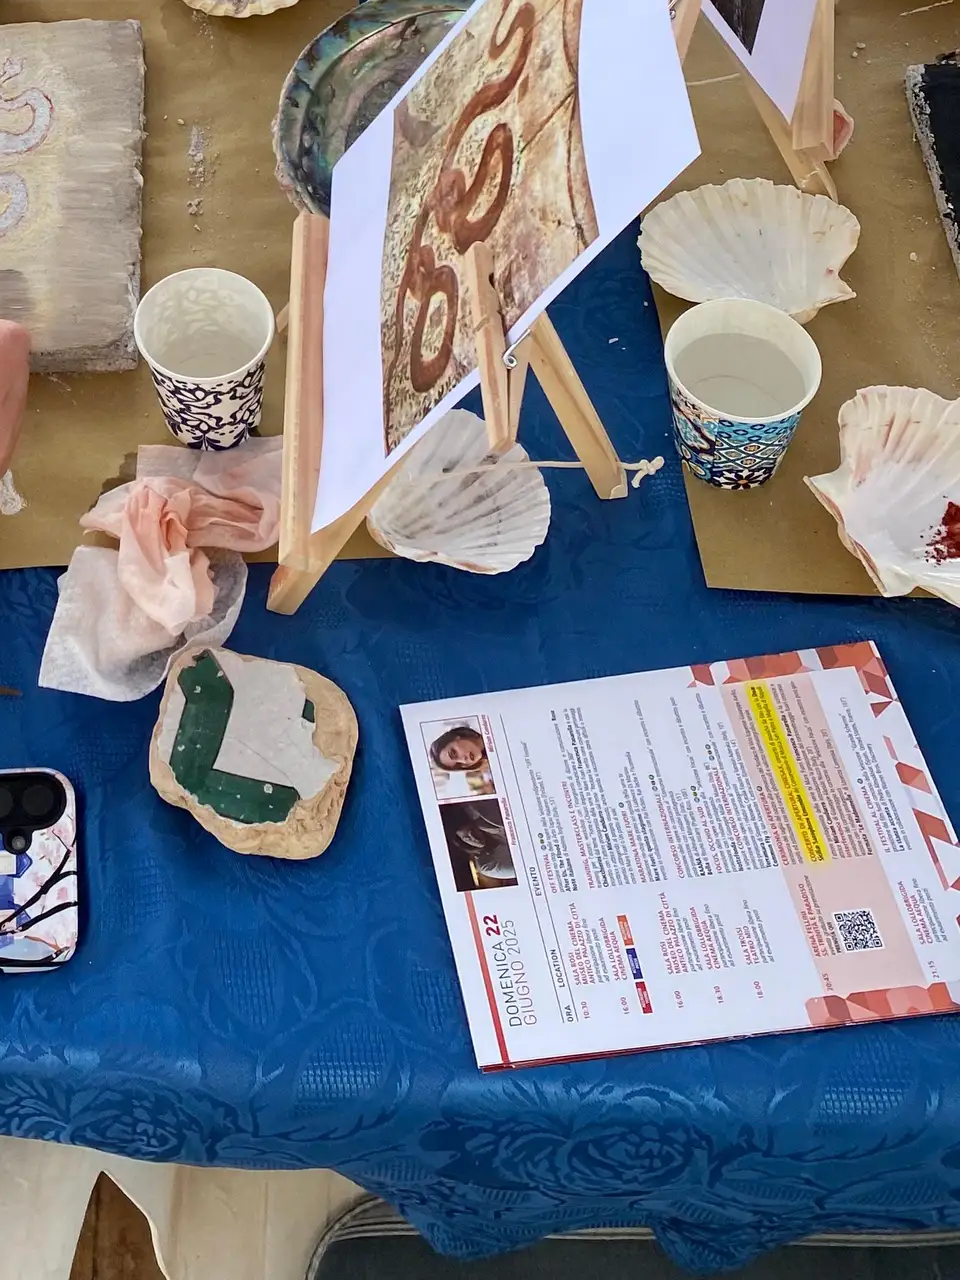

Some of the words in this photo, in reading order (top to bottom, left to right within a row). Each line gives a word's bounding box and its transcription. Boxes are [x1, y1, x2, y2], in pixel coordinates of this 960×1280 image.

[560, 780, 574, 808] INCONTRI
[710, 766, 733, 815] INTERNAZIONALE
[858, 785, 874, 809] CINEMA
[653, 792, 675, 843] INTERNAZIONALE
[696, 805, 705, 818] SUD
[757, 791, 774, 821] APERTURA
[868, 810, 878, 818] AL
[620, 809, 631, 828] FUORI
[700, 819, 708, 827] AL
[797, 821, 806, 829] DI
[570, 814, 587, 857] MASTERCLASS
[626, 829, 636, 847] MARE
[703, 827, 716, 851] OCCHIO
[727, 816, 745, 849] CONCORSO
[872, 818, 889, 846] FESTIVAL
[553, 843, 563, 858] Flood
[771, 830, 790, 866] CERIMONIA
[800, 830, 818, 862] CONCERTO
[542, 853, 554, 880] FESTIVAL
[557, 858, 565, 866] The
[631, 847, 647, 883] MARATONA
[669, 844, 685, 879] CONCORSO
[528, 865, 542, 896] EVENTO
[549, 881, 558, 893] OFF
[562, 877, 572, 892] After
[569, 878, 578, 891] Note
[657, 891, 669, 909] CITTÀ
[797, 882, 814, 915] PARADISO
[895, 880, 920, 927] LOLLOBRIGIDA
[908, 894, 923, 917] AEQUA
[567, 902, 579, 920] CITTÀ
[656, 909, 670, 935] CINEMA
[664, 909, 672, 917] DI
[799, 910, 813, 934] FELLINI
[482, 913, 501, 937] 22
[500, 919, 521, 955] 2025
[566, 920, 579, 946] CINEMA
[666, 918, 681, 946] PALAZZO
[688, 906, 708, 951] LOLLOBRIGIDA
[700, 919, 713, 942] AEQUA
[734, 926, 747, 947] TROISI
[741, 924, 752, 939] MIO
[914, 927, 927, 945] SALA
[917, 917, 934, 944] CINEMA
[576, 929, 589, 957] PALAZZO
[597, 916, 616, 963] LOLLOBRIGIDA
[608, 930, 621, 953] AEQUA
[658, 940, 669, 956] ROSI
[664, 936, 674, 949] DEL
[746, 939, 760, 964] TEATRO
[808, 934, 821, 957] ARENA
[567, 951, 577, 967] ROSI
[573, 947, 582, 960] DEL
[668, 949, 682, 974] MUSEO
[675, 948, 689, 973] ANTICO
[702, 952, 714, 970] SALA
[707, 942, 721, 969] CINEMA
[741, 947, 753, 965] SALA
[549, 948, 565, 988] LOCATION
[571, 968, 581, 986] SALA
[576, 960, 589, 985] MUSEO
[583, 959, 596, 984] ANTICO
[610, 963, 621, 981] SALA
[615, 954, 628, 980] CINEMA
[663, 957, 674, 975] SALA
[490, 940, 522, 1027] DOMENICA
[509, 959, 538, 1026] GIUGNO
[563, 1004, 574, 1022] ORA
[579, 1000, 590, 1019] 10:30
[619, 996, 630, 1014] 16:00
